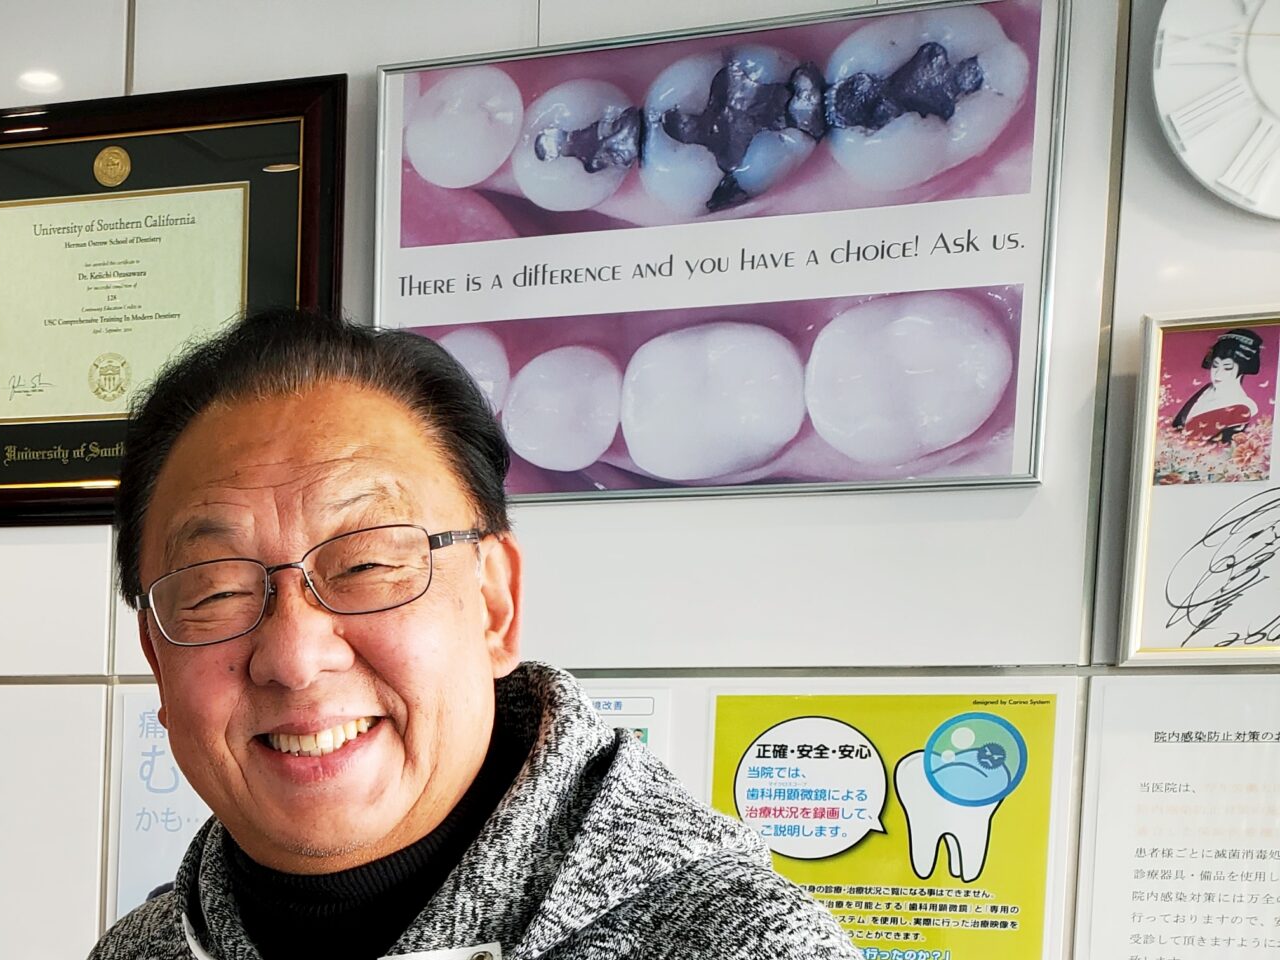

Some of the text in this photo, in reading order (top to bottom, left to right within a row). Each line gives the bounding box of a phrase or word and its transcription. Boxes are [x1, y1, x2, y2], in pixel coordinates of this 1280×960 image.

[33, 213, 196, 237] University of Southern California
[466, 273, 482, 292] is
[930, 229, 981, 256] Ask
[3, 444, 69, 467] University
[756, 744, 872, 760] 正確・安全・安心
[139, 744, 180, 794] む
[747, 766, 807, 779] 当院では、
[746, 788, 868, 801] 歯科用顕微鏡による
[1138, 782, 1197, 794] 当医院は、
[745, 805, 873, 820] 治療状況を録画して、
[760, 825, 847, 838] ご説明します。
[835, 915, 1018, 929] ステム」を使用し、実際に行った治療映像を
